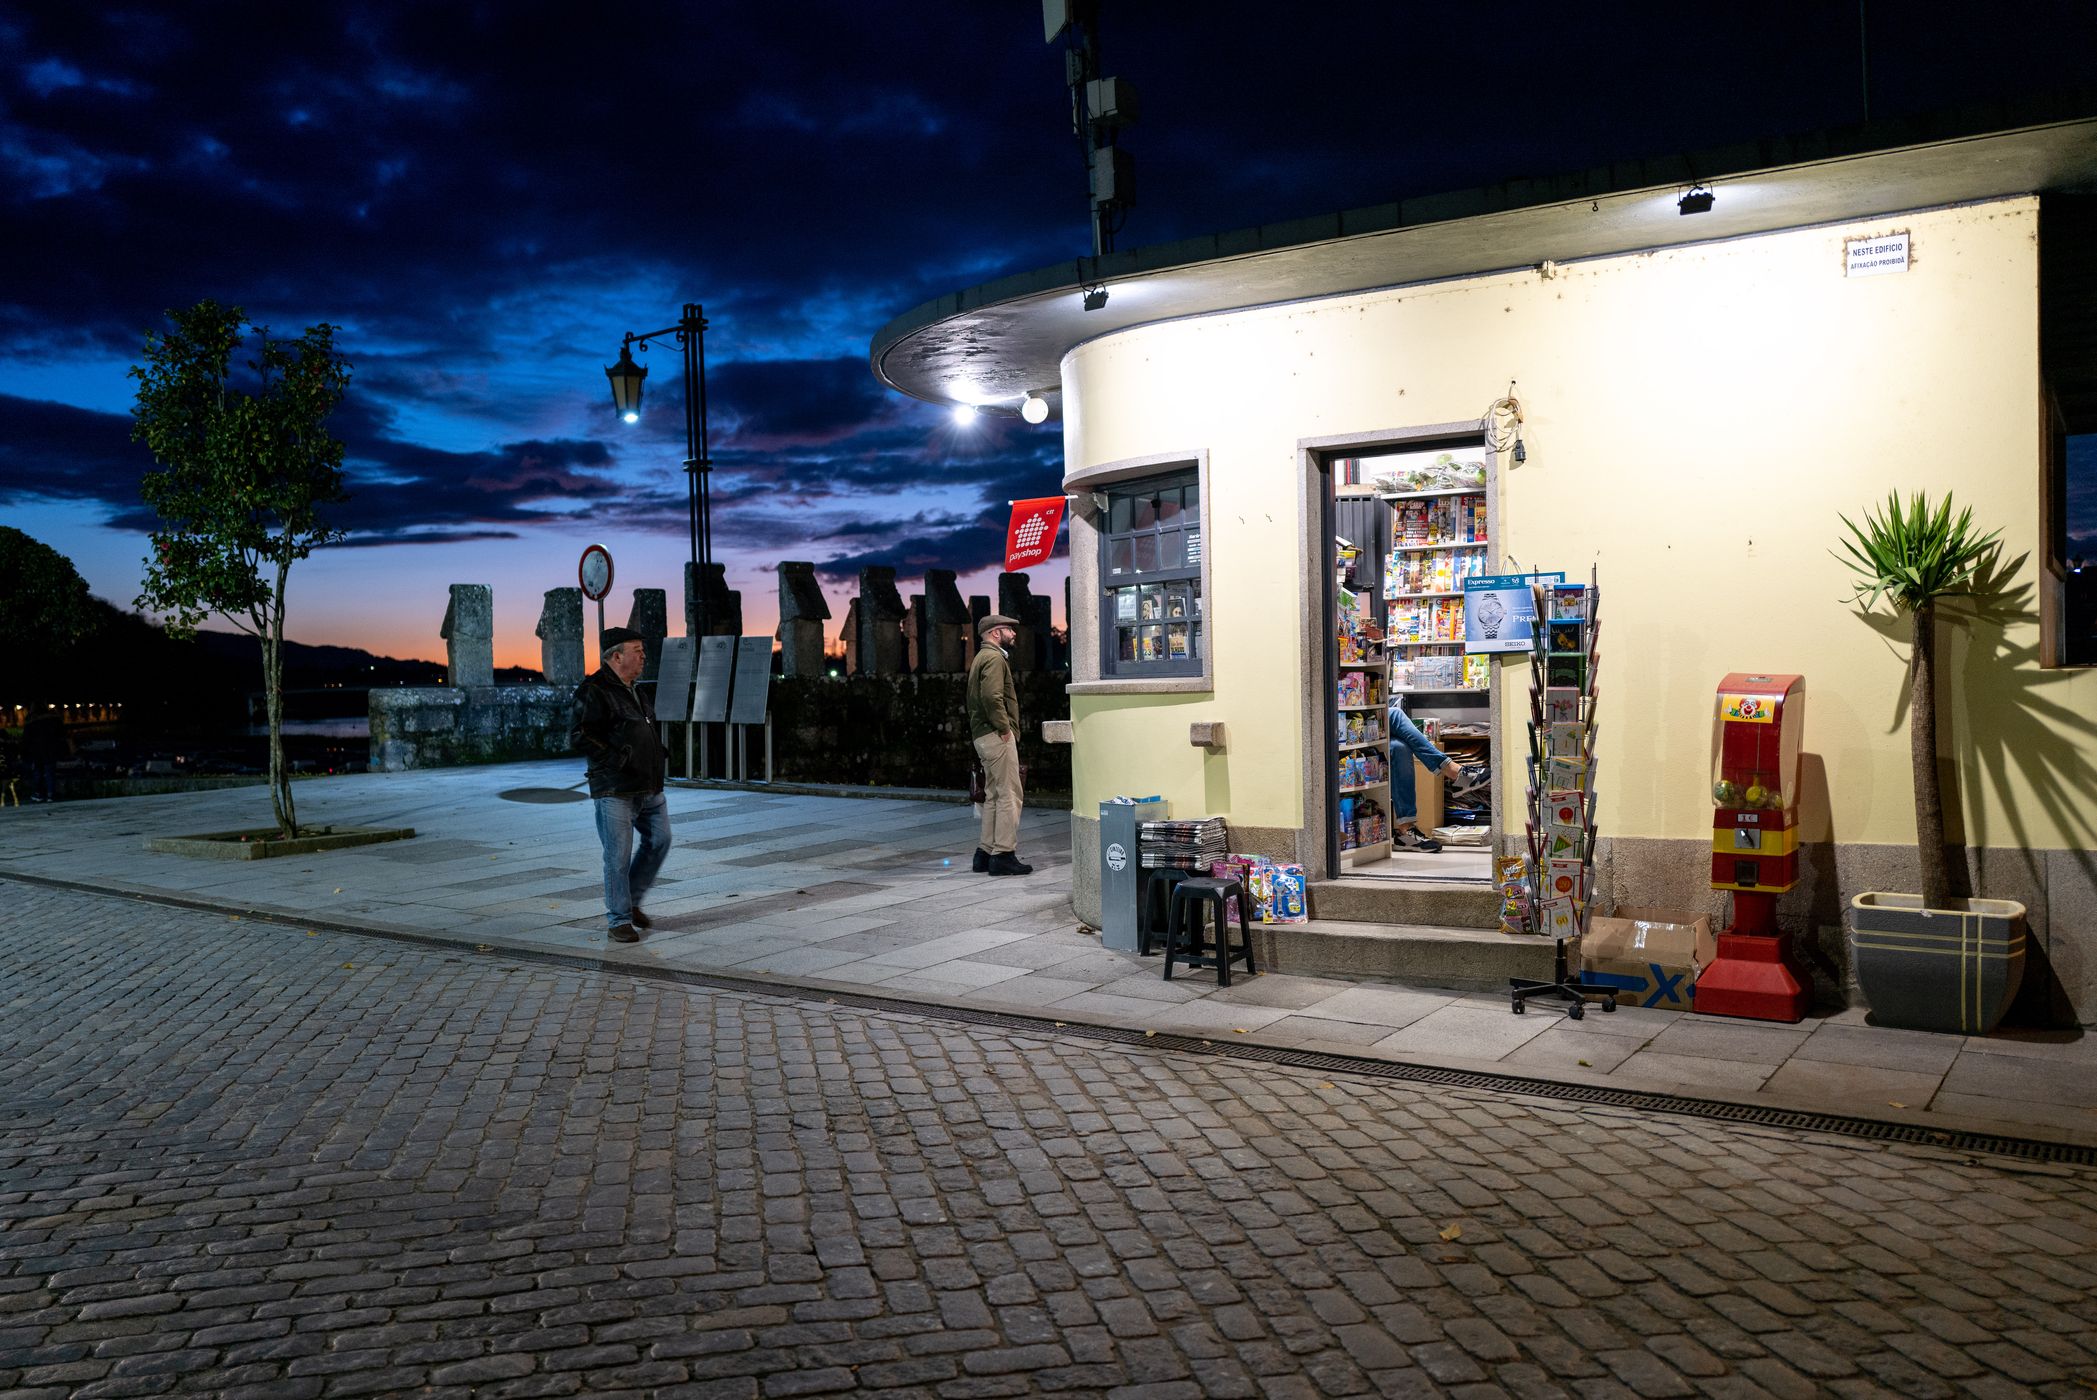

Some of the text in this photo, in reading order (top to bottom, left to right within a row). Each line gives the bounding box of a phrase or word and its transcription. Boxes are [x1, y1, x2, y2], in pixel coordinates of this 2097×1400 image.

[1853, 247, 1873, 256] NESTE
[1879, 256, 1904, 265] PROIBIDA
[1009, 549, 1042, 562] payshop
